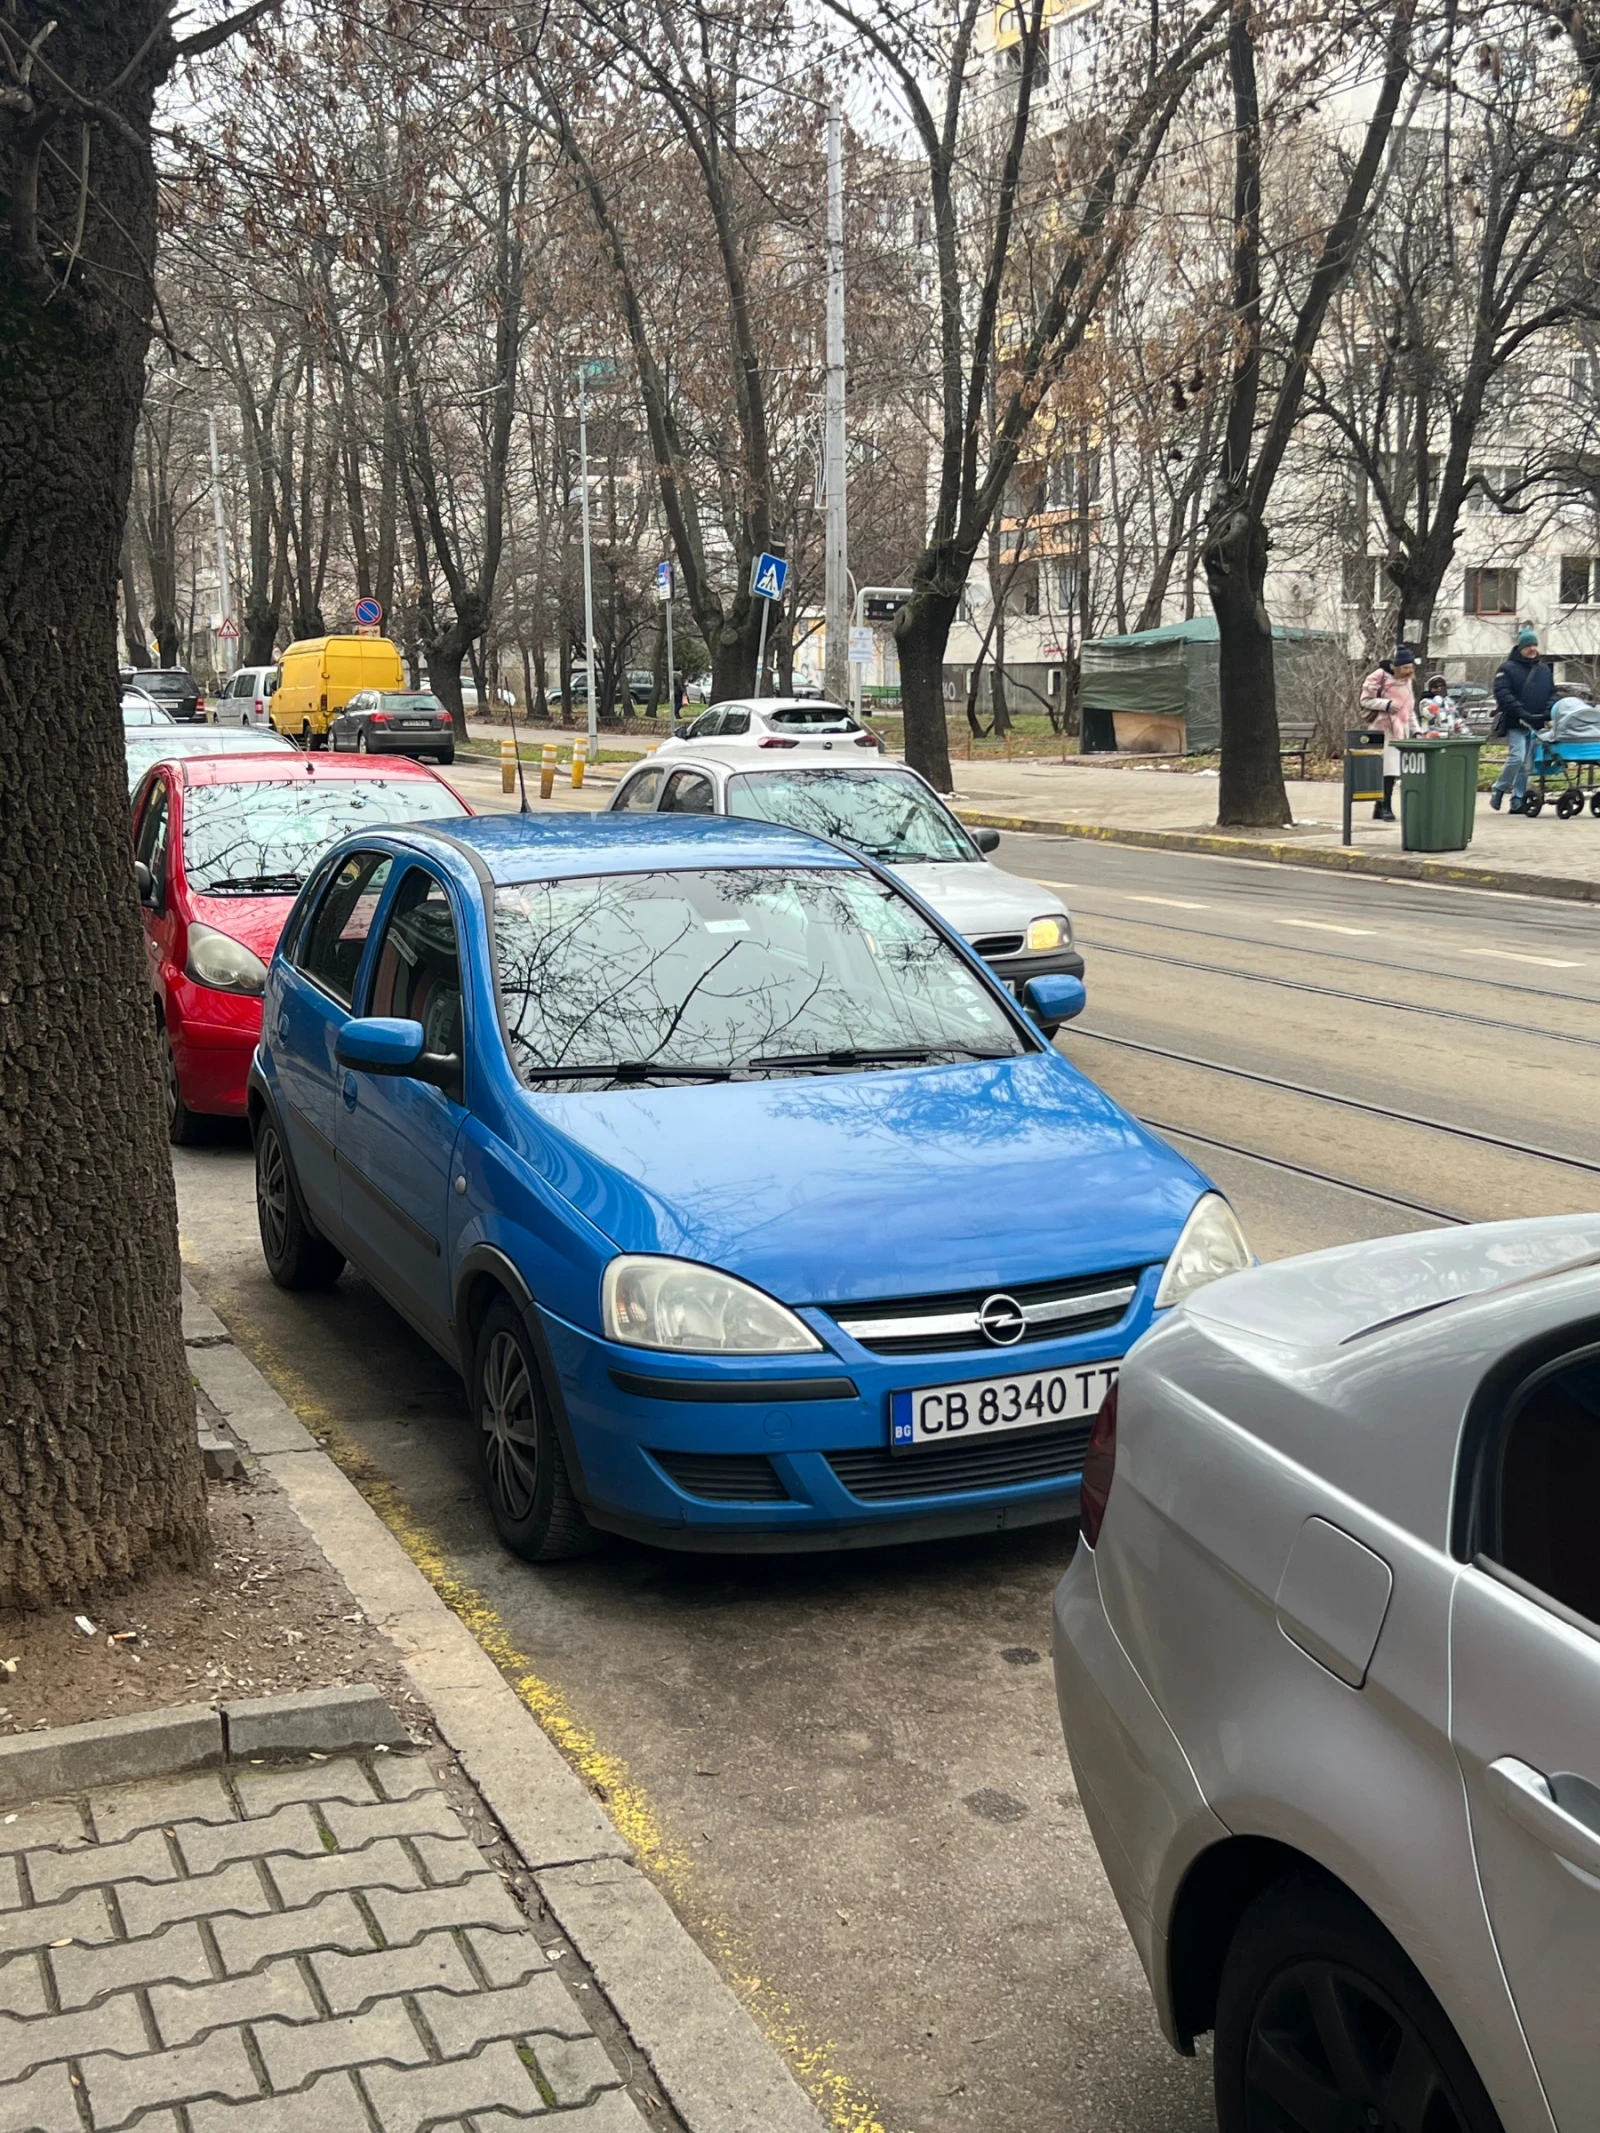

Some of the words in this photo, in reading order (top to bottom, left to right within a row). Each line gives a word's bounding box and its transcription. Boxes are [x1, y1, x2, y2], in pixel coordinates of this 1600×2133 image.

[1401, 752, 1426, 774] СОЛ
[920, 1391, 969, 1434] CB
[978, 1376, 1067, 1425] 8340
[895, 1425, 911, 1438] BG
